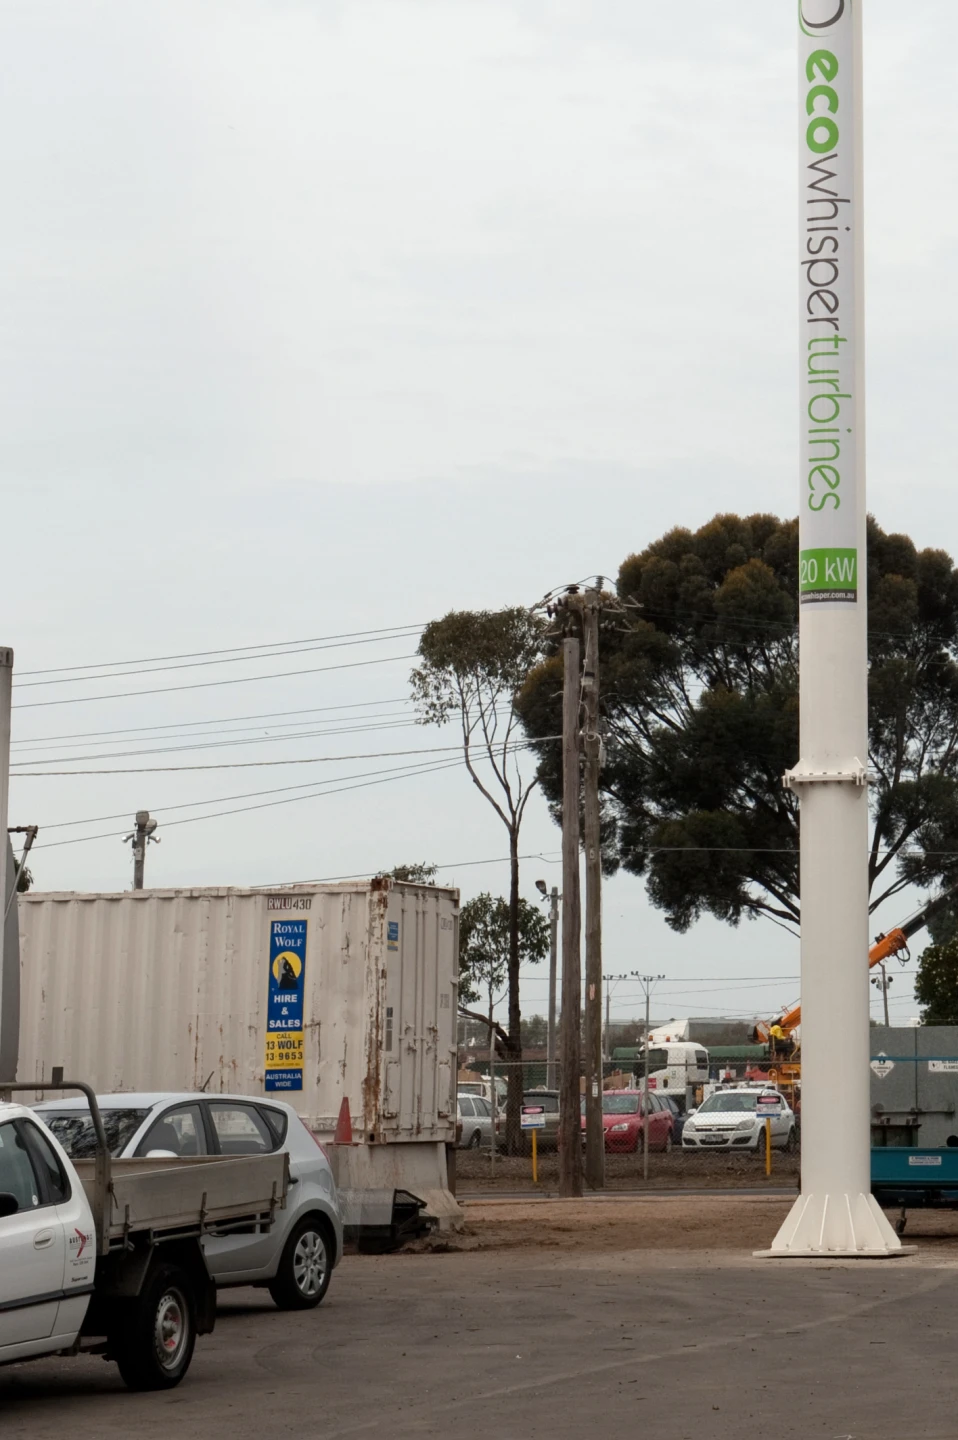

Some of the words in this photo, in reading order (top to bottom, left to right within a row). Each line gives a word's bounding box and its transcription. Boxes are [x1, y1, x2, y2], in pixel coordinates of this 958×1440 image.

[801, 558, 818, 585] 20
[825, 557, 855, 583] kW
[268, 898, 292, 910] RWLU
[293, 898, 312, 910] 430
[273, 923, 305, 934] ROYAL
[275, 936, 303, 948] WOLF
[274, 994, 298, 1003] HIRE
[281, 1006, 289, 1015] &
[269, 1019, 301, 1028] SALES
